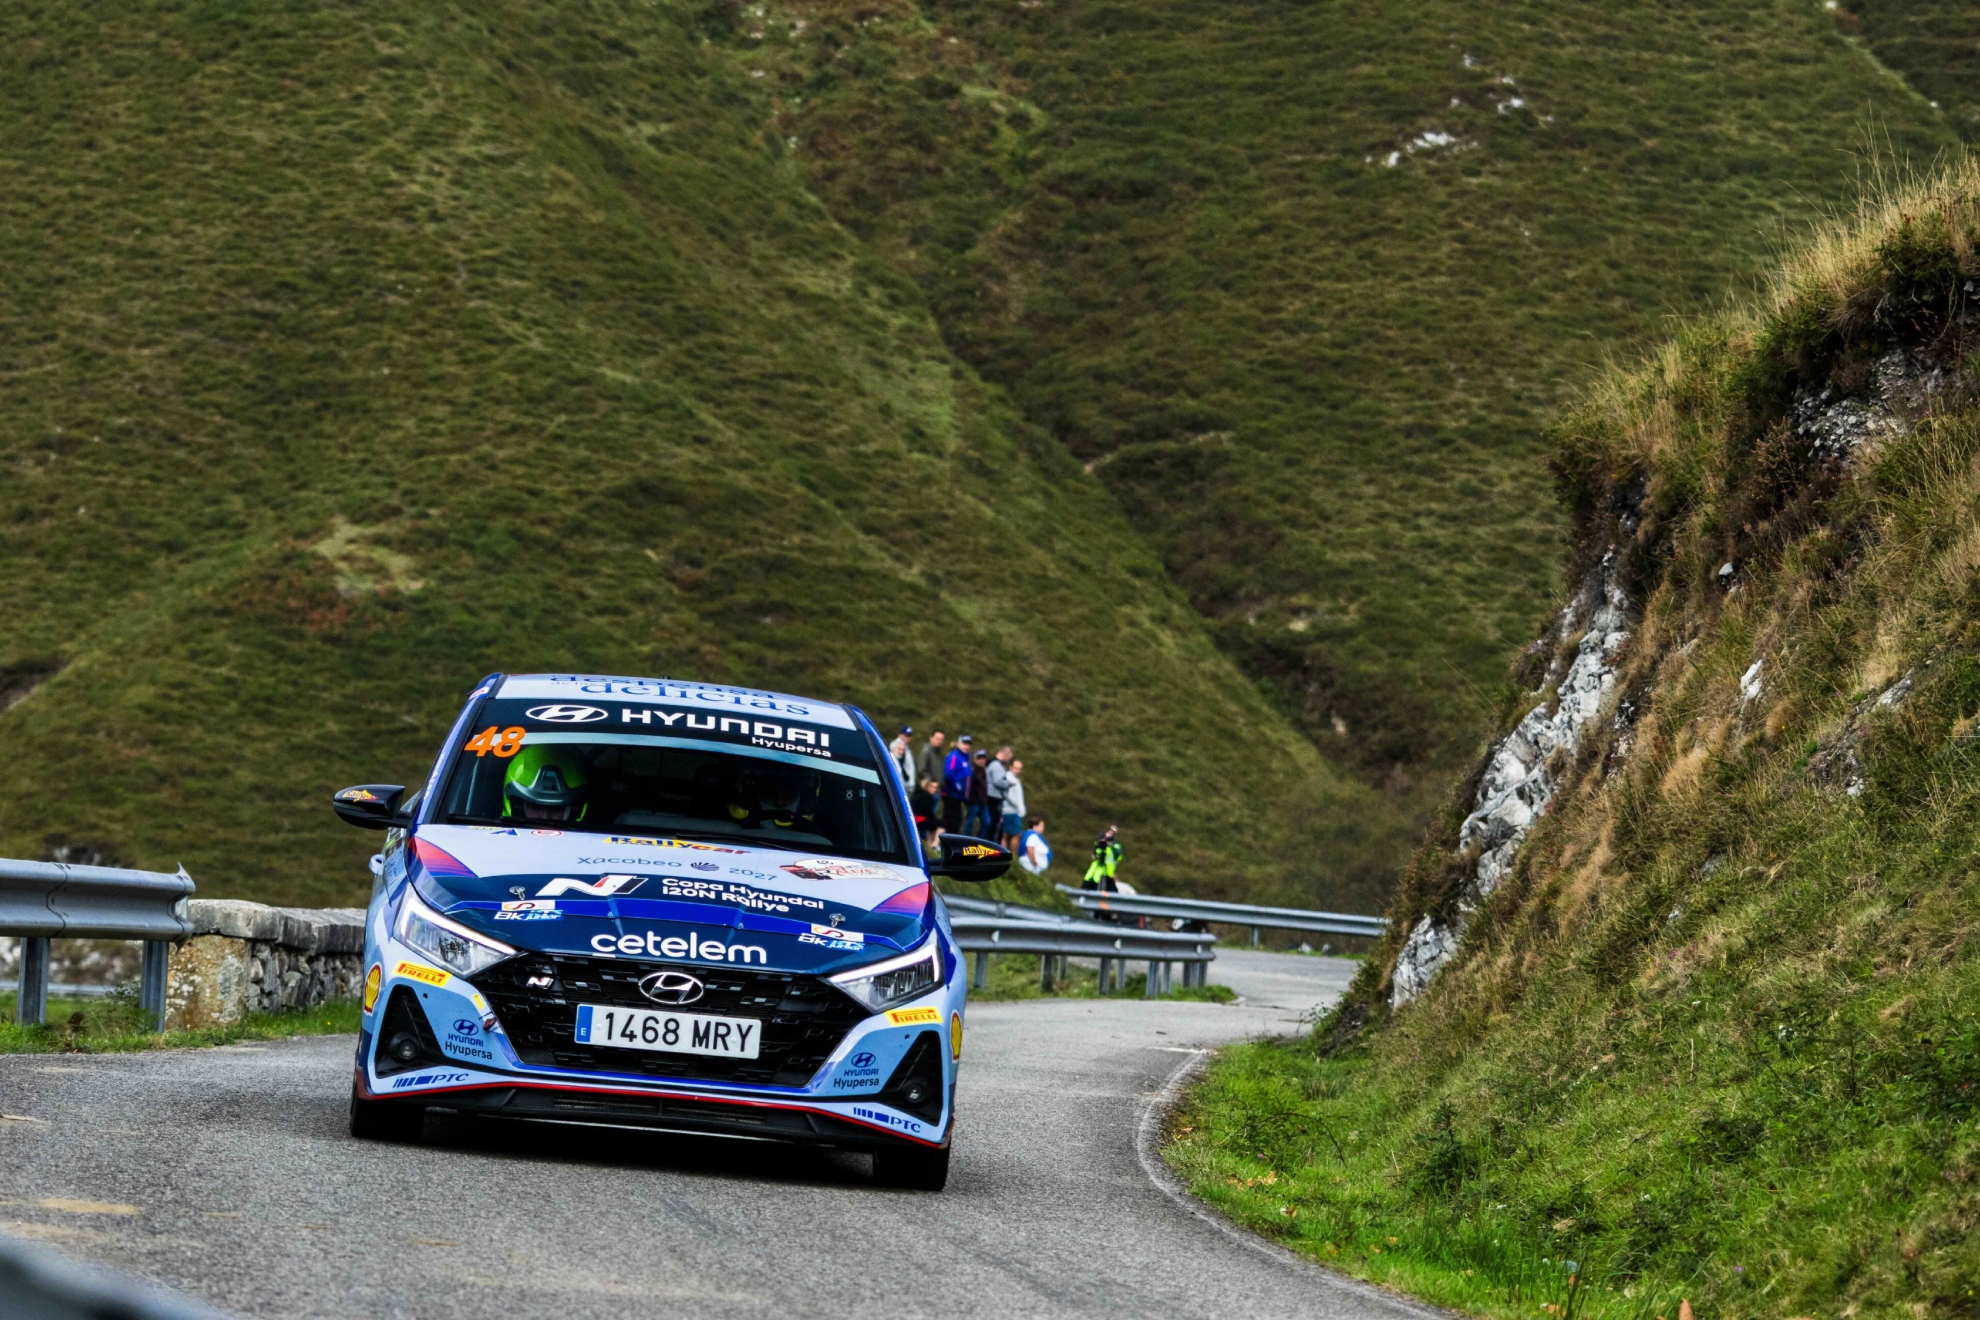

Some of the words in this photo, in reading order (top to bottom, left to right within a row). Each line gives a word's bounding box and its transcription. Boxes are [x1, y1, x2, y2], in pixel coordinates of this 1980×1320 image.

[581, 683, 809, 715] delicias
[622, 708, 829, 747] HYUNDAI
[464, 726, 526, 758] 48
[752, 737, 831, 757] Hyupersa
[729, 867, 778, 881] 2027
[662, 878, 724, 890] Copa
[729, 884, 824, 910] Hyundai
[721, 892, 790, 913] Rallye
[590, 930, 767, 964] cetelem
[397, 963, 446, 985] PIRELLI
[891, 1009, 938, 1024] PIRELLI
[447, 1033, 484, 1047] HYUNDAI
[580, 1027, 587, 1036] E
[605, 1012, 680, 1046] 1468
[691, 1019, 754, 1052] MRY
[444, 1041, 493, 1060] Hyupersa
[430, 1073, 470, 1084] PTC
[843, 1068, 879, 1077] HYUNDAI
[833, 1076, 880, 1090] Hyupersa
[889, 1115, 921, 1134] PTC
